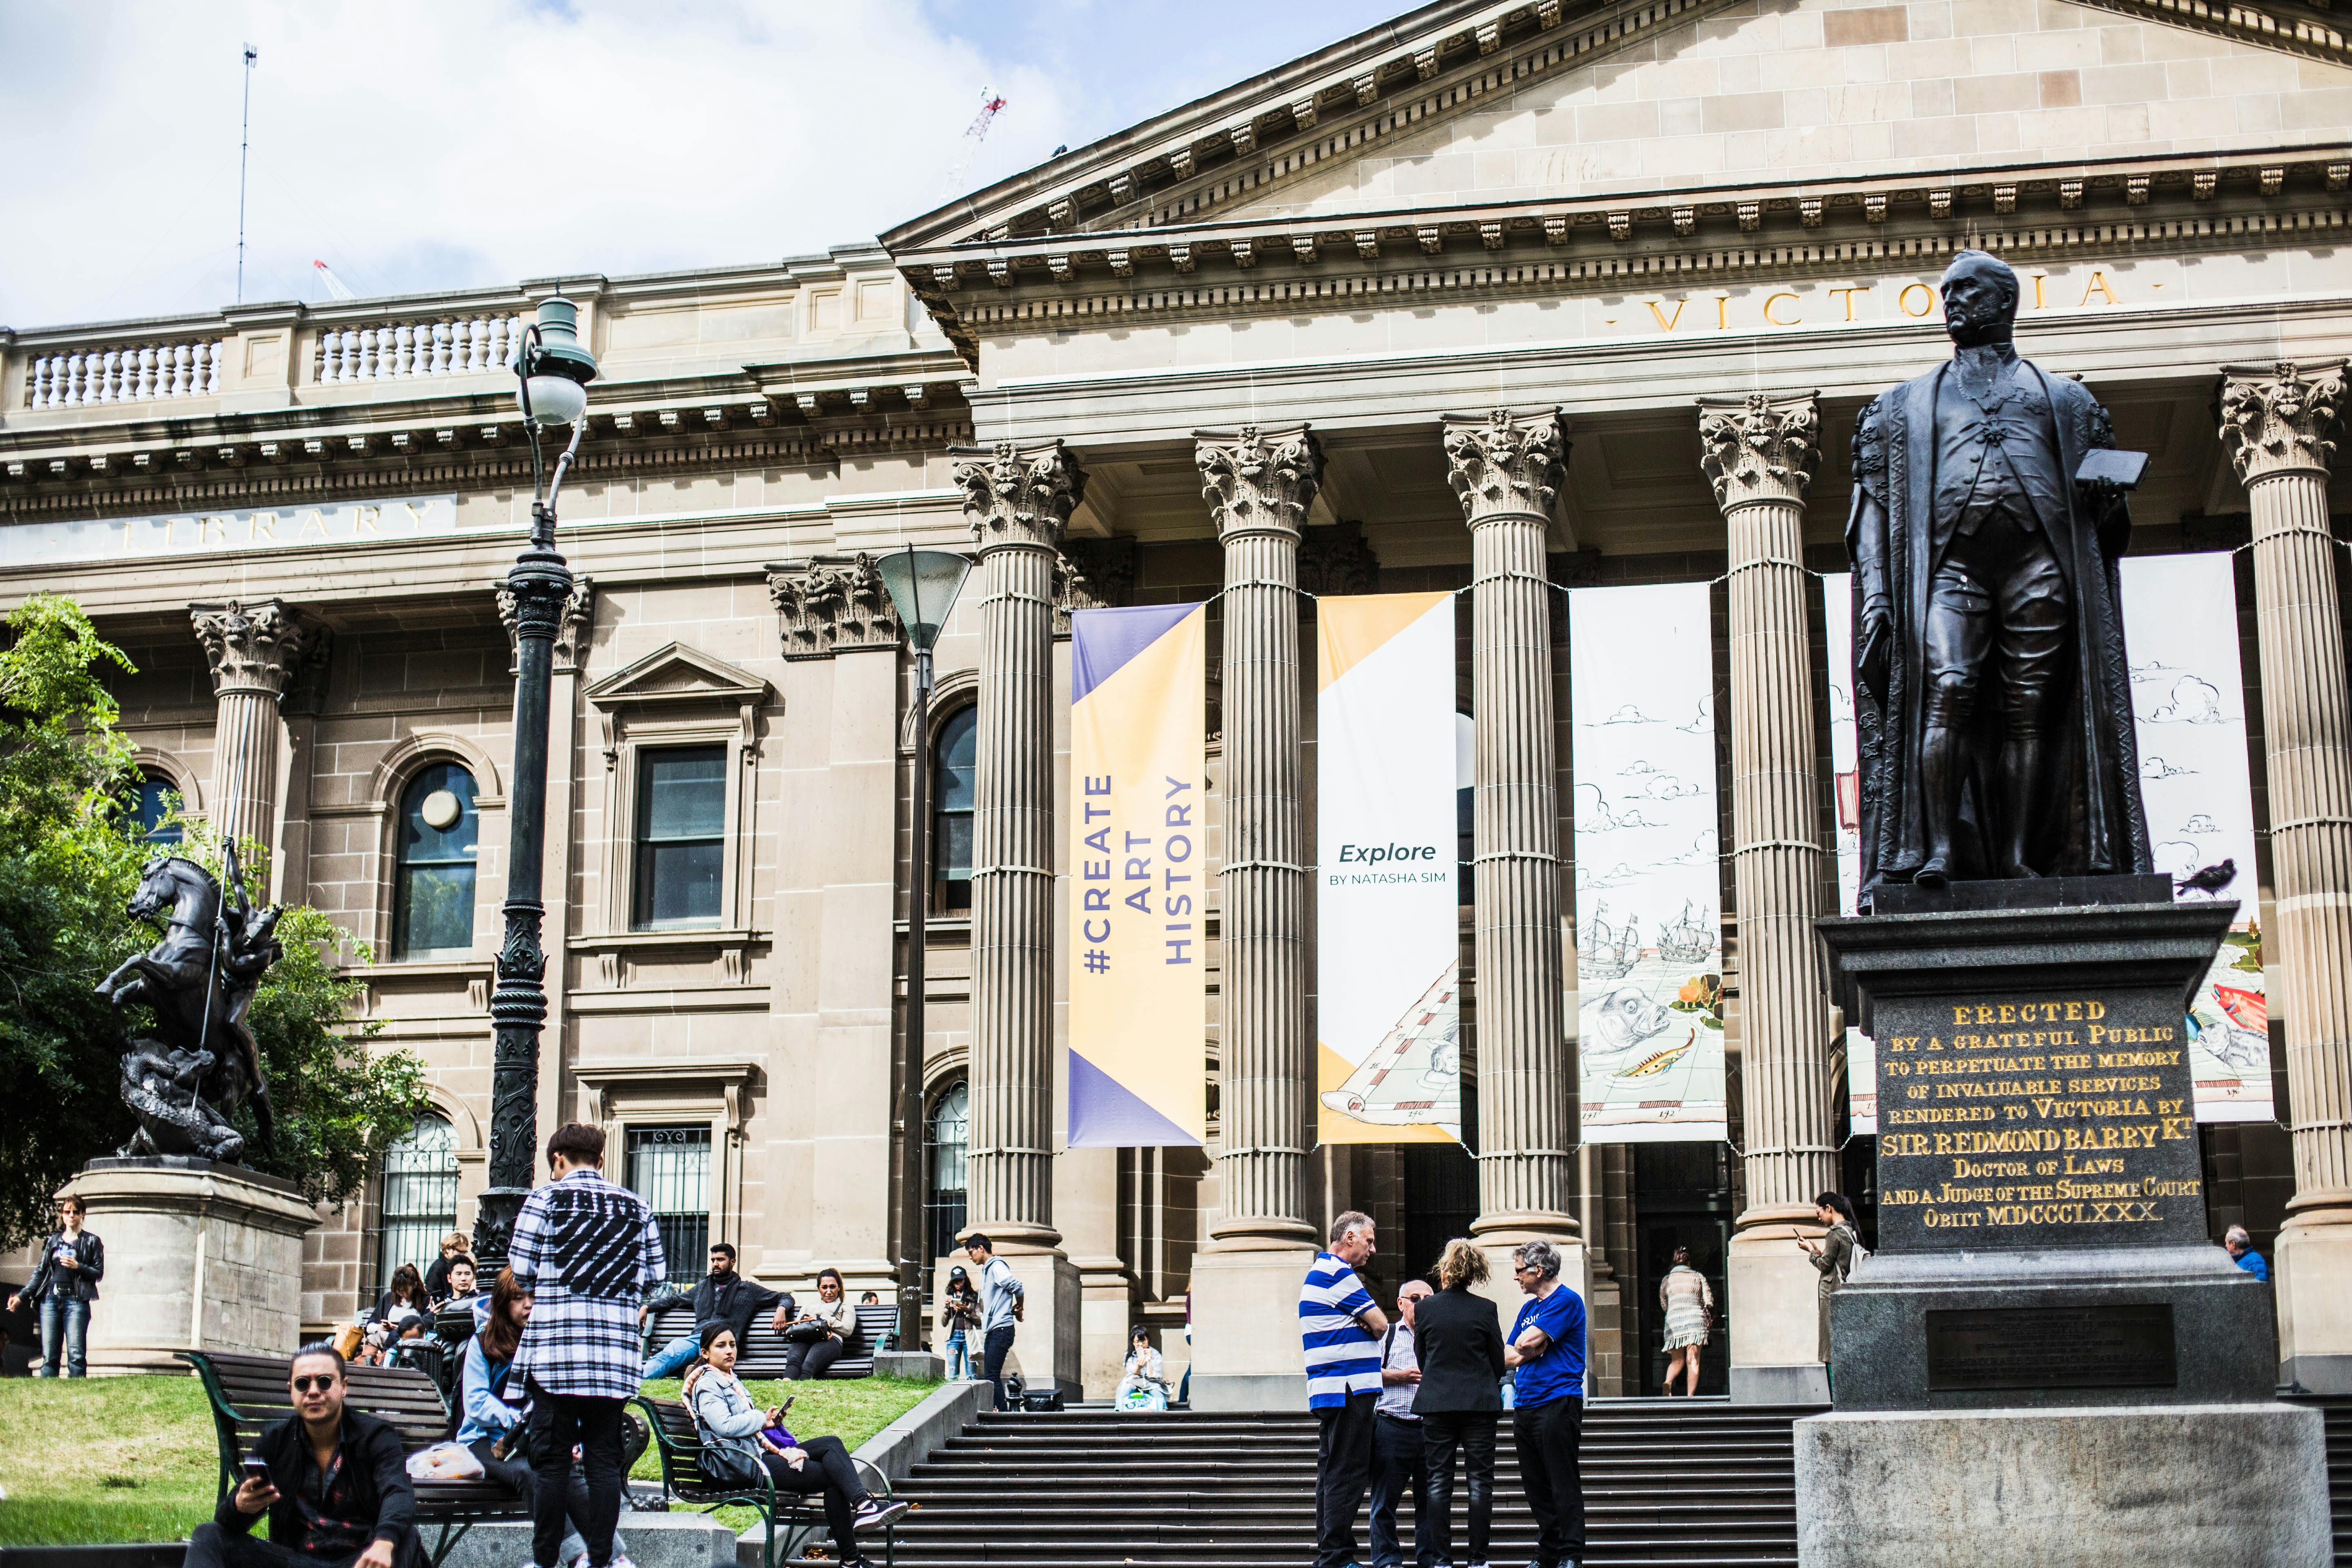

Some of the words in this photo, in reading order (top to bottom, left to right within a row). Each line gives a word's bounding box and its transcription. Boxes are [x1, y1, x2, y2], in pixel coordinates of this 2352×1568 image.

[1643, 270, 2123, 332] VICTOIA
[122, 502, 436, 550] LIBRARY
[1339, 842, 1436, 866] Explore
[1084, 775, 1111, 974] #CREATE
[1125, 831, 1151, 914] ART
[1165, 775, 1192, 965] HISTORY
[1330, 875, 1347, 885] BY
[1352, 873, 1417, 884] NATASHA
[1421, 872, 1446, 882] SIM
[1952, 1000, 2107, 1027] ERECTED
[1891, 1036, 1920, 1053] BY
[1927, 1036, 1945, 1051] A
[1953, 1030, 2080, 1050] GRATEFUL
[1884, 1061, 1911, 1077] TO
[1915, 1055, 2047, 1076] PERPETUATE
[2049, 1053, 2093, 1071] THE
[2097, 1049, 2182, 1069] MEMORY
[1907, 1084, 1931, 1100] OF
[1936, 1079, 2063, 1099] INVALUABLE
[2068, 1075, 2163, 1094] SERVICES
[1889, 1106, 1997, 1125] RENDERED
[2002, 1105, 2029, 1120] TO
[2157, 1098, 2185, 1116] BY
[1880, 1132, 1933, 1158] SIR
[1933, 1128, 2062, 1155] REDMOND
[2062, 1124, 2160, 1151] BARRY
[2036, 1160, 2060, 1176] OF
[1880, 1189, 1920, 1205] AND
[1920, 1189, 1936, 1205] A
[1995, 1186, 2017, 1202] OF
[2016, 1184, 2055, 1202] THE
